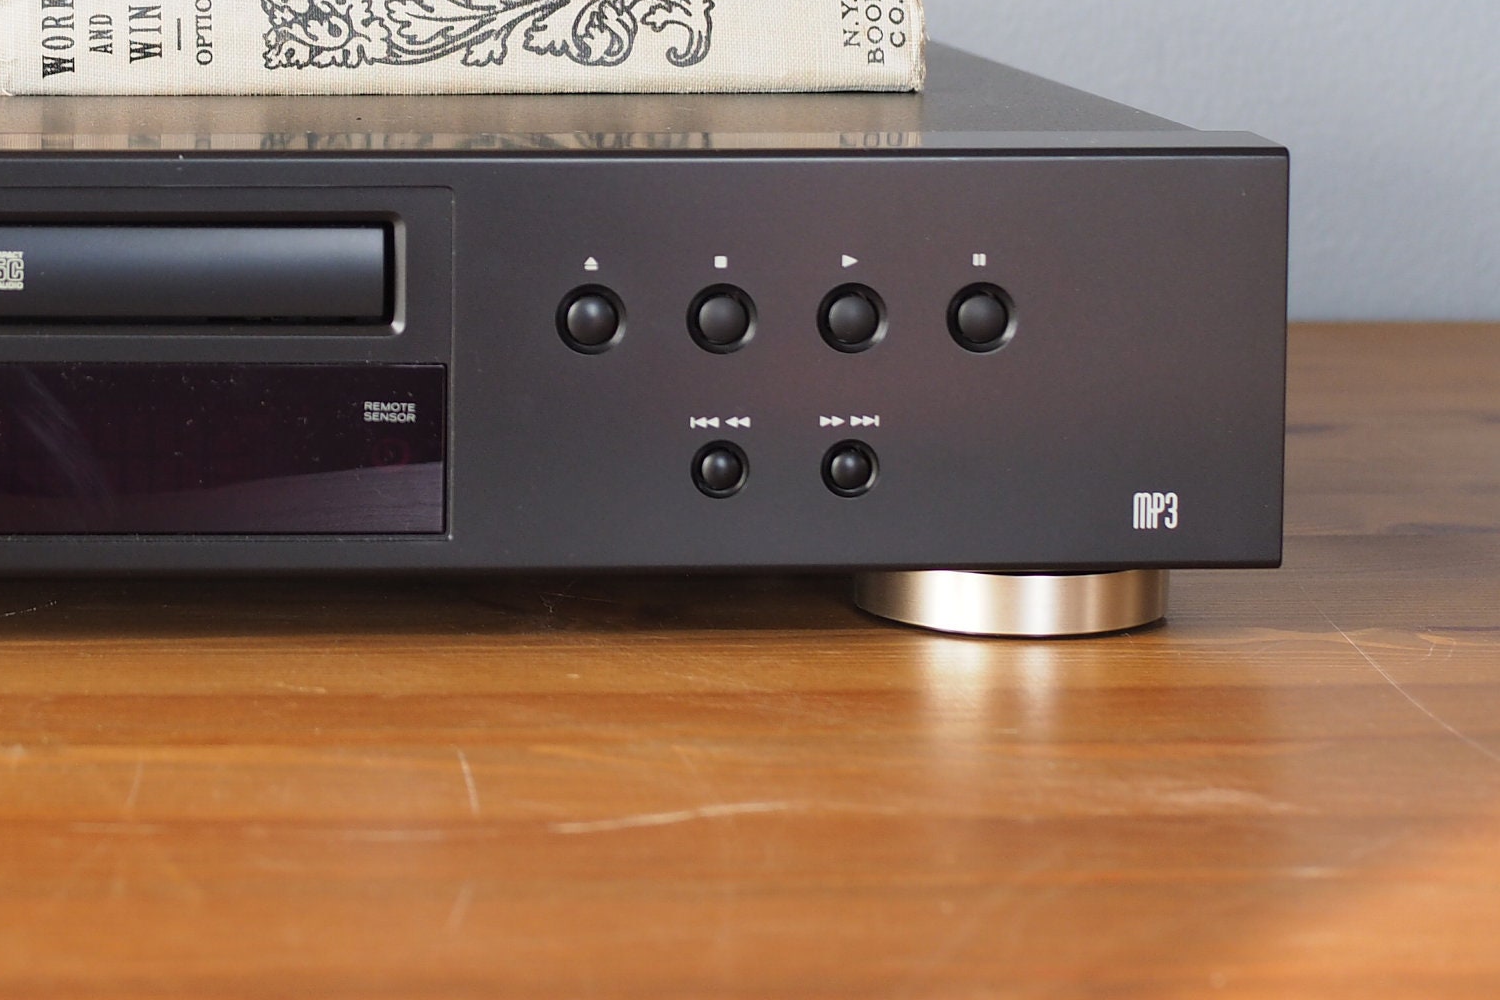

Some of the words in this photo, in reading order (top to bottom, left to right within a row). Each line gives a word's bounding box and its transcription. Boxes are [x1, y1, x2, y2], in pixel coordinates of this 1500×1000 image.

[89, 14, 113, 55] AND
[128, 5, 162, 64] WIN
[363, 401, 416, 412] REMOTE
[363, 411, 417, 423] SENSOR
[1132, 491, 1179, 530] MP3
